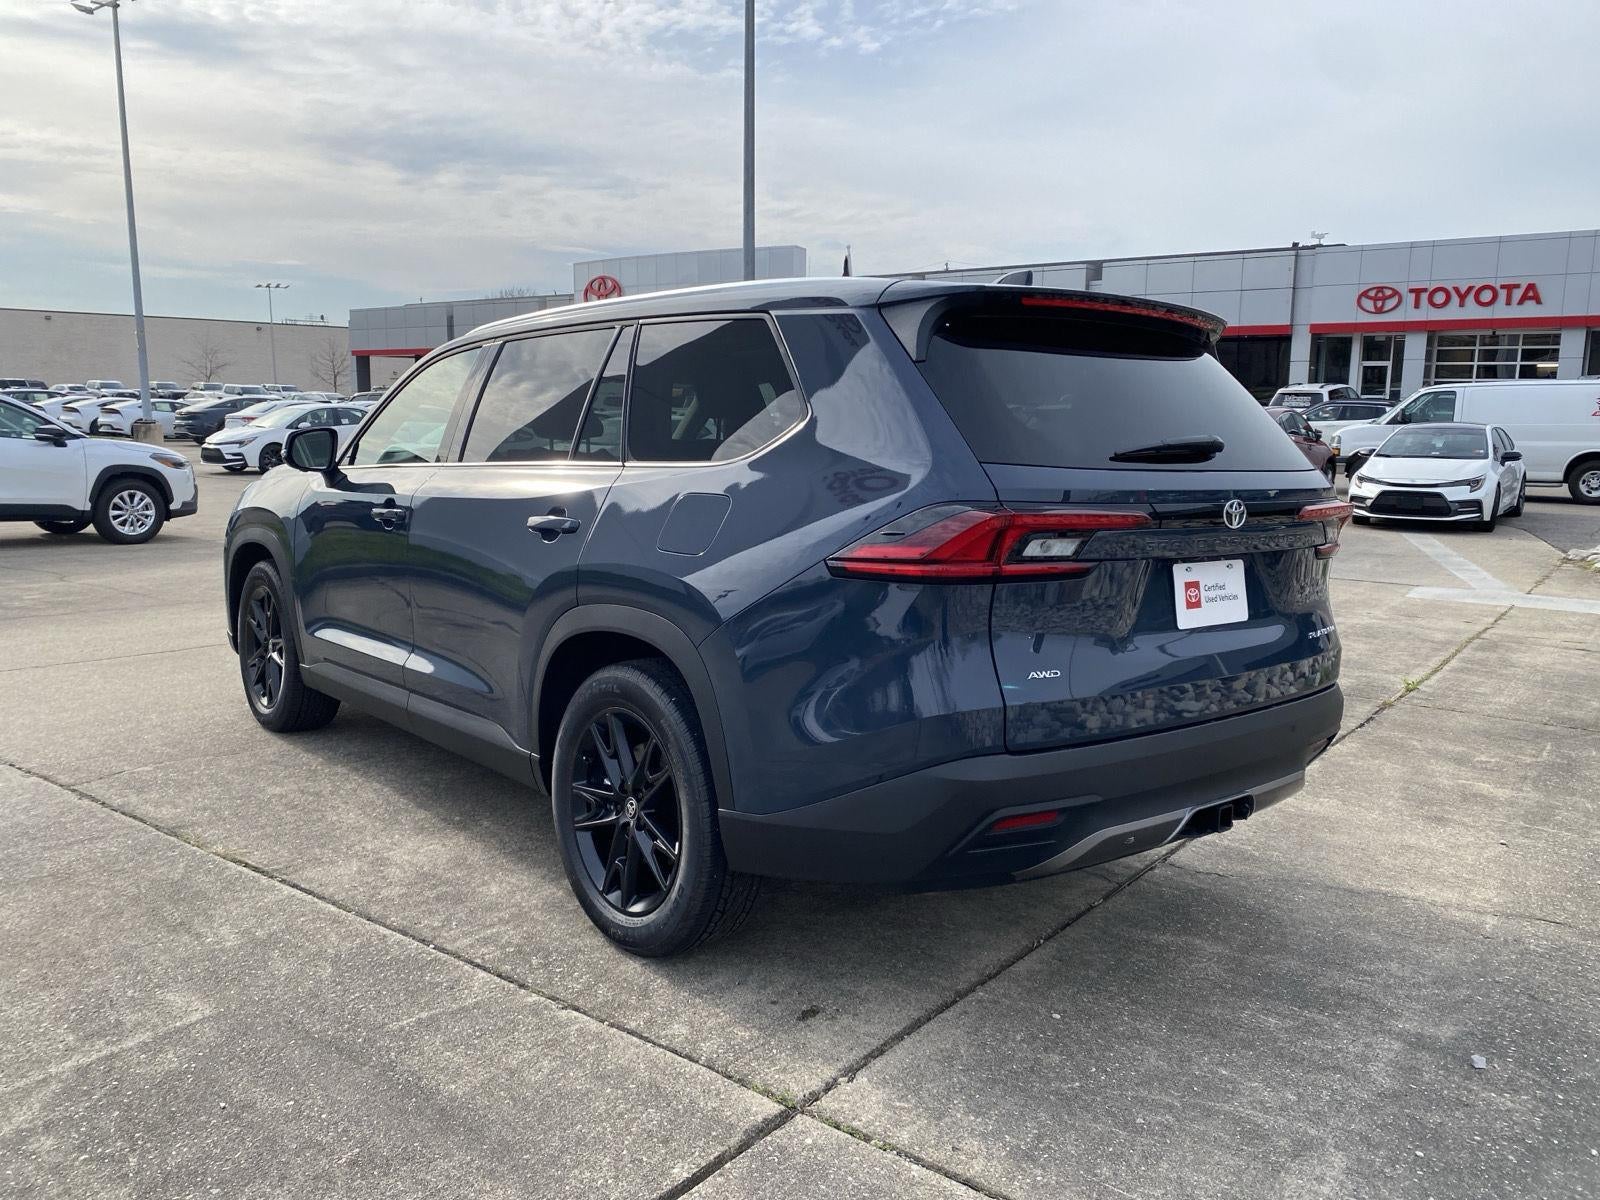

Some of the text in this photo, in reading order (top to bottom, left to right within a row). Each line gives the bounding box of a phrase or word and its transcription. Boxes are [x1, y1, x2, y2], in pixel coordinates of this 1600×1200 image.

[1408, 283, 1543, 309] TOYOTA
[1203, 582, 1226, 592] Certified
[1204, 592, 1239, 603] Used Vehicles
[1027, 669, 1061, 680] AWD
